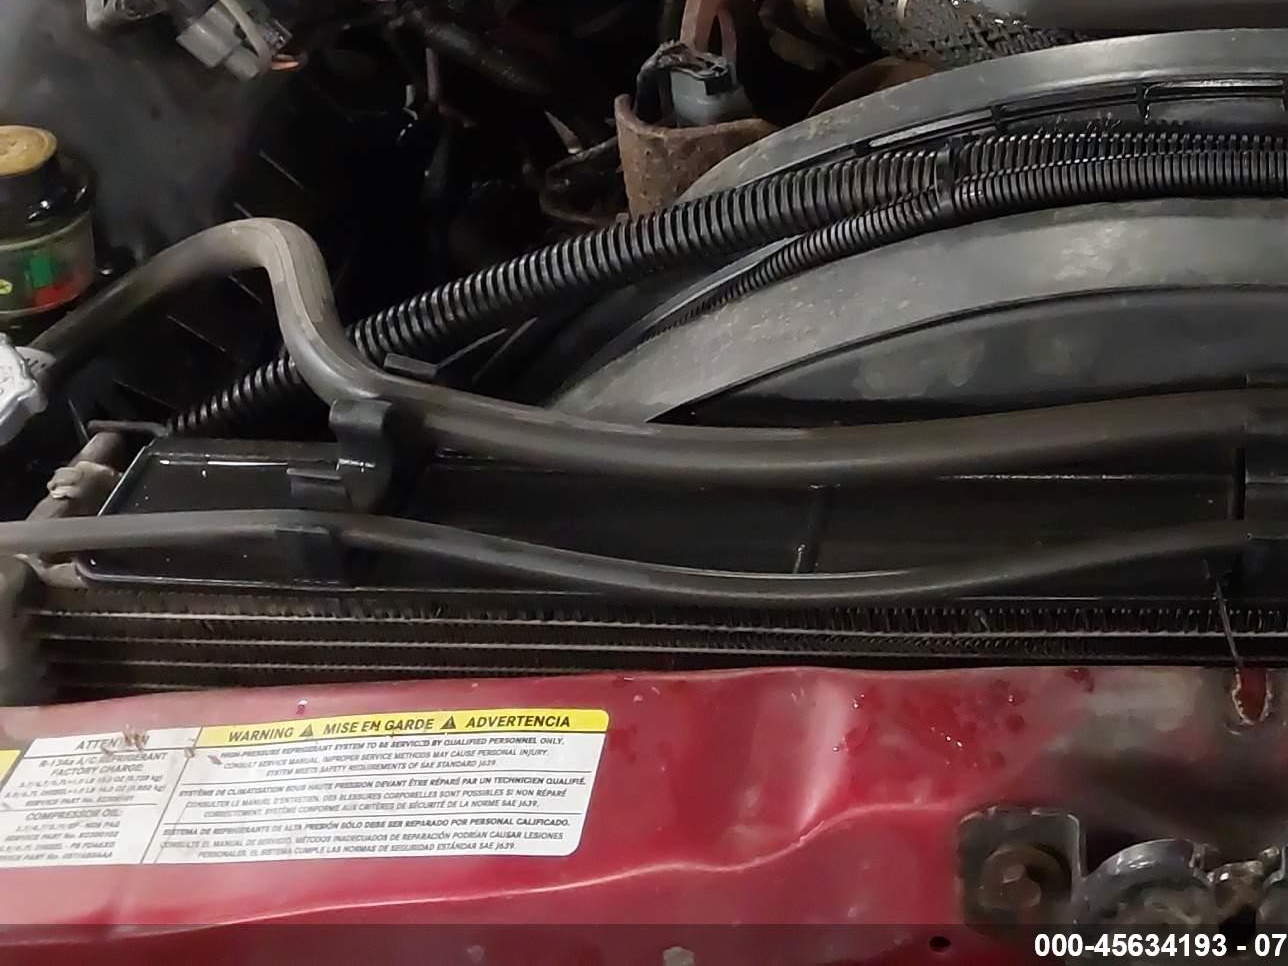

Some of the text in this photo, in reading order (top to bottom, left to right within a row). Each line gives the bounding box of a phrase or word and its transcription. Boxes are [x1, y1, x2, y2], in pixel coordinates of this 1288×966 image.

[228, 715, 571, 743] WARNING MISE EN GARDE ADVERTENCIA
[334, 742, 365, 751] SYSTEM
[366, 741, 377, 750] TO
[378, 740, 390, 749] BE
[431, 738, 443, 747] BY
[443, 737, 487, 746] QUALIFIED
[488, 736, 538, 745] PERSONNEL
[76, 757, 98, 766] A/C
[258, 757, 288, 767] SERVICE
[361, 751, 392, 762] SERVICE
[394, 749, 431, 759] METHODS
[432, 749, 449, 758] MAY
[450, 748, 477, 757] CAUSE
[477, 747, 517, 757] PERSONAL
[50, 766, 98, 777] FACTORY
[266, 767, 294, 777] SYSTEM
[319, 764, 347, 775] SAFETY
[348, 761, 407, 771] REQUIREMENTS
[407, 761, 420, 769] OF
[420, 760, 435, 769] SAE
[436, 760, 477, 769] STANDARD
[214, 788, 226, 796] DE
[226, 785, 284, 796] CLIMATISATION
[285, 784, 307, 793] SOUS
[308, 783, 333, 792] HAUTE
[334, 781, 374, 790] PRESSION
[375, 779, 407, 788] DEVANT
[429, 777, 461, 786] RÉPARÉ
[461, 776, 478, 785] PAR
[479, 777, 492, 785] UN
[493, 776, 545, 785] TECHNICIEN
[185, 799, 229, 809] CONSULTER
[241, 798, 272, 807] MANUEL
[321, 794, 338, 803] DES
[338, 791, 382, 802] BLESSURES
[383, 789, 438, 799] CORPORELLES
[438, 789, 461, 798] SONT
[462, 789, 505, 797] POSSIBLES
[505, 789, 514, 797] SI
[515, 788, 534, 797] NON
[535, 787, 567, 797] RÉPARÉ
[298, 804, 340, 814] CONFORME
[341, 803, 357, 812] AUX
[395, 801, 407, 810] DE
[447, 800, 459, 808] DE
[459, 800, 470, 808] LA
[470, 800, 501, 808] NORME
[501, 799, 517, 807] SAE
[25, 809, 101, 821] COMPRESSOR
[162, 826, 199, 836] SISTEMA
[199, 827, 212, 835] DE
[270, 824, 282, 832] DE
[283, 823, 302, 832] ALTA
[364, 820, 386, 830] DEBE
[387, 819, 404, 828] SER
[405, 818, 449, 827] REPARADO
[450, 818, 468, 826] POR
[469, 817, 514, 826] PERSONAL
[213, 839, 244, 848] MANUAL
[245, 839, 257, 847] DE
[332, 834, 388, 843] INADECUADOS
[389, 833, 401, 841] DE
[489, 831, 522, 839] CAUSAR
[523, 832, 564, 840] LESIONES
[260, 847, 293, 857] SISTEMA
[293, 846, 325, 855] CUMPLE
[326, 845, 342, 853] LAS
[342, 844, 375, 853] NORMAS
[376, 843, 389, 852] DE
[479, 842, 494, 851] SAE
